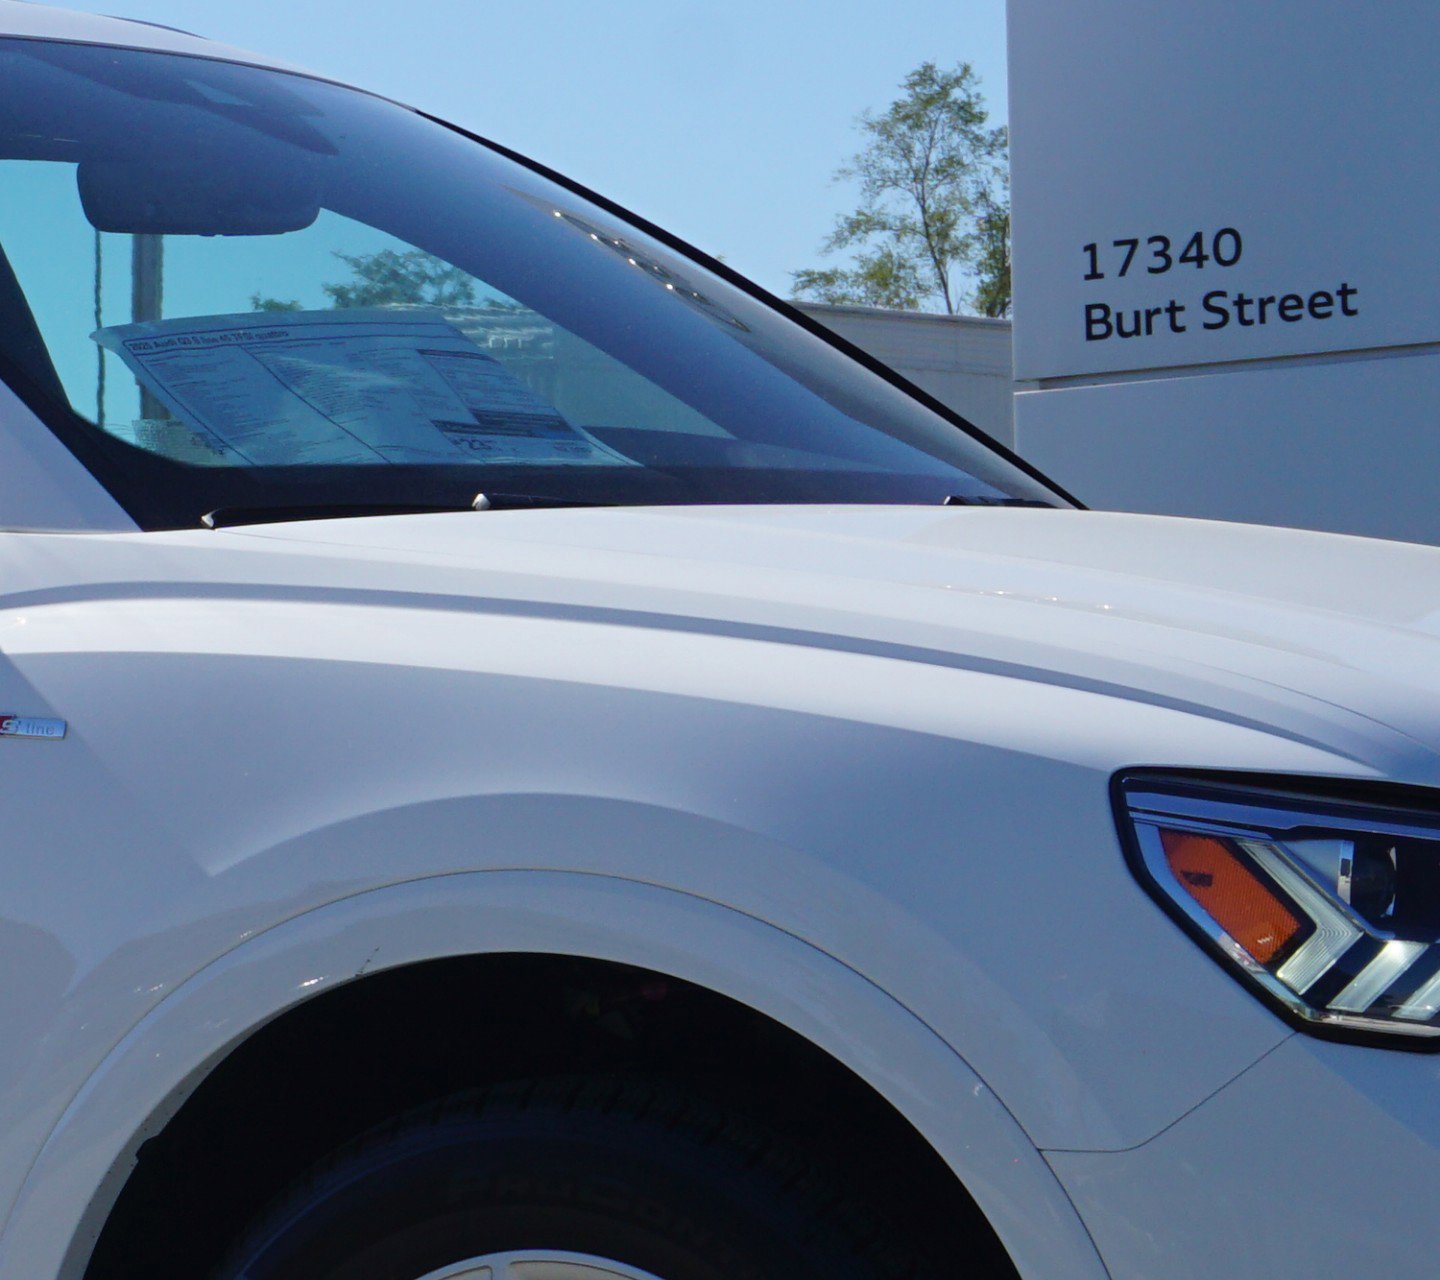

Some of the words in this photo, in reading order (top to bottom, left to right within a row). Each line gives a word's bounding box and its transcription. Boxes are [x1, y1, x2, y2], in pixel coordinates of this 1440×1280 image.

[1082, 227, 1244, 282] 17340
[1084, 300, 1187, 342] Burt
[1202, 282, 1359, 331] Street
